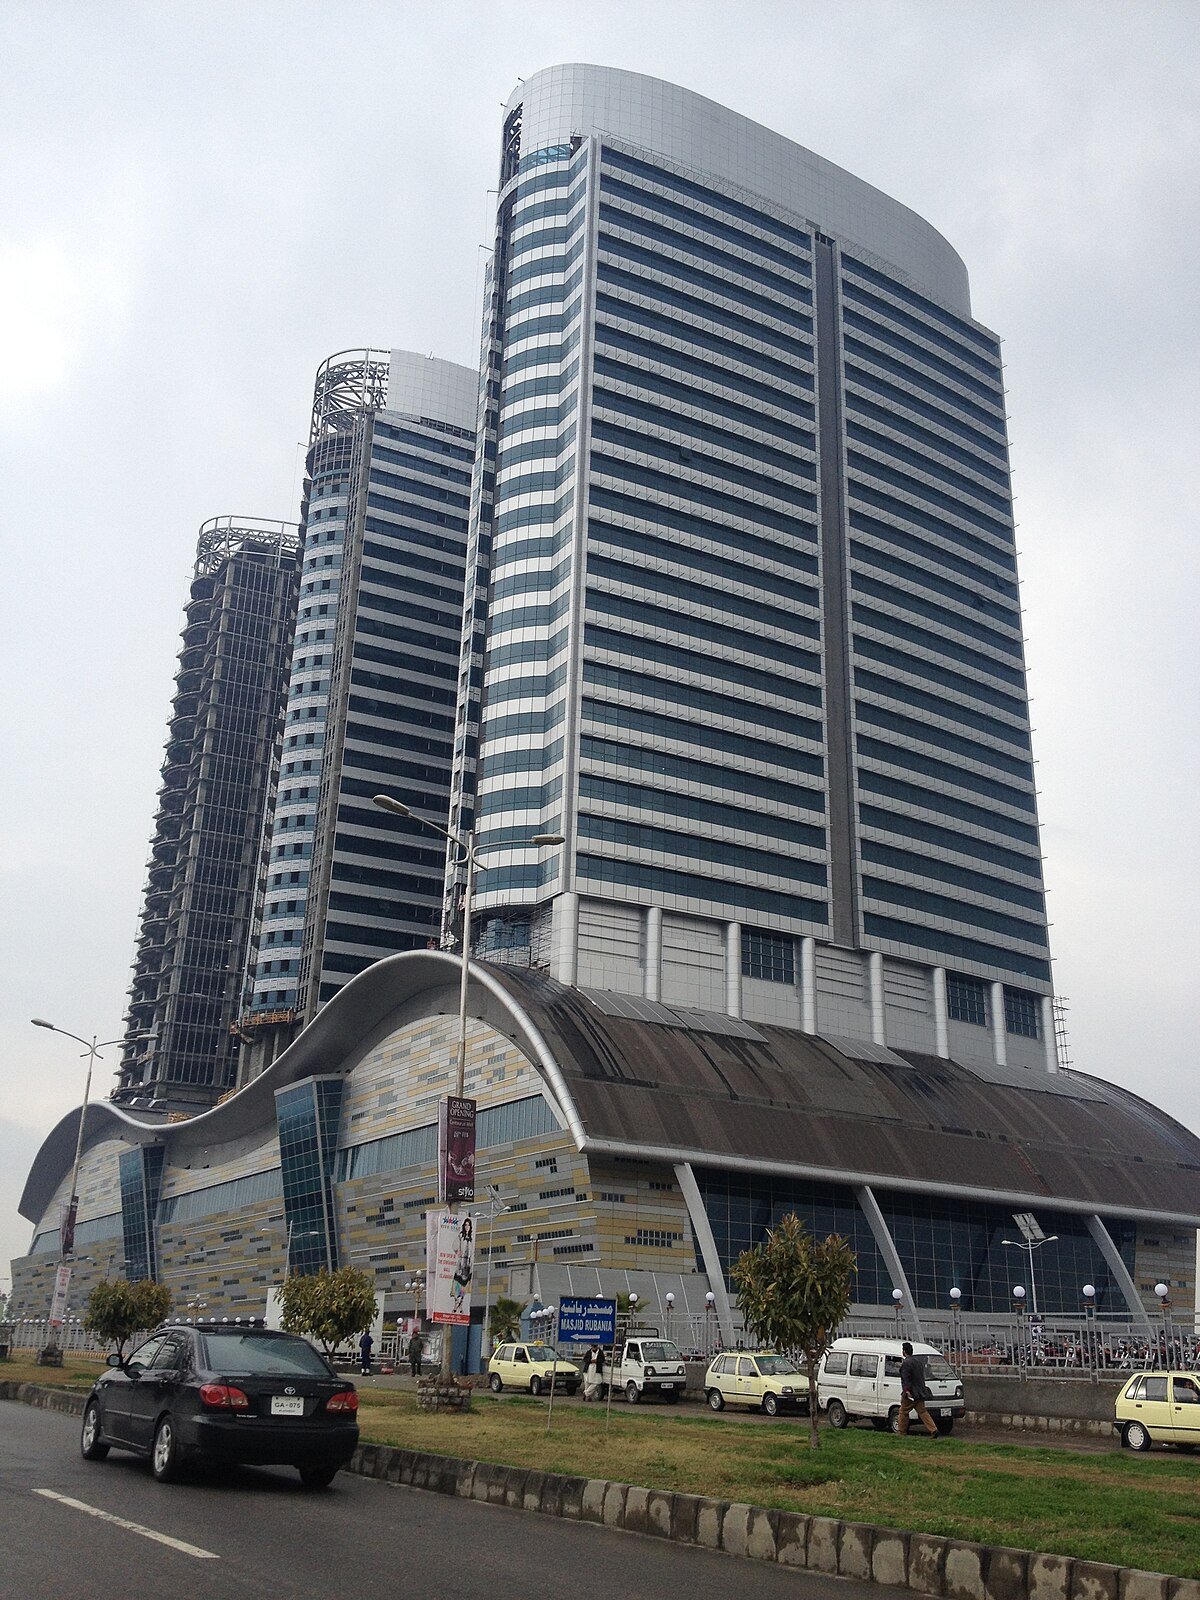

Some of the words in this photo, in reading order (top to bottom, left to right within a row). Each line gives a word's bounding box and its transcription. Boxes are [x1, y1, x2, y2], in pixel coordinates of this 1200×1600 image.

[452, 1100, 472, 1110] GRAND
[450, 1108, 474, 1118] OPENING
[561, 1319, 584, 1331] MASJID
[585, 1320, 612, 1332] RUBANIA
